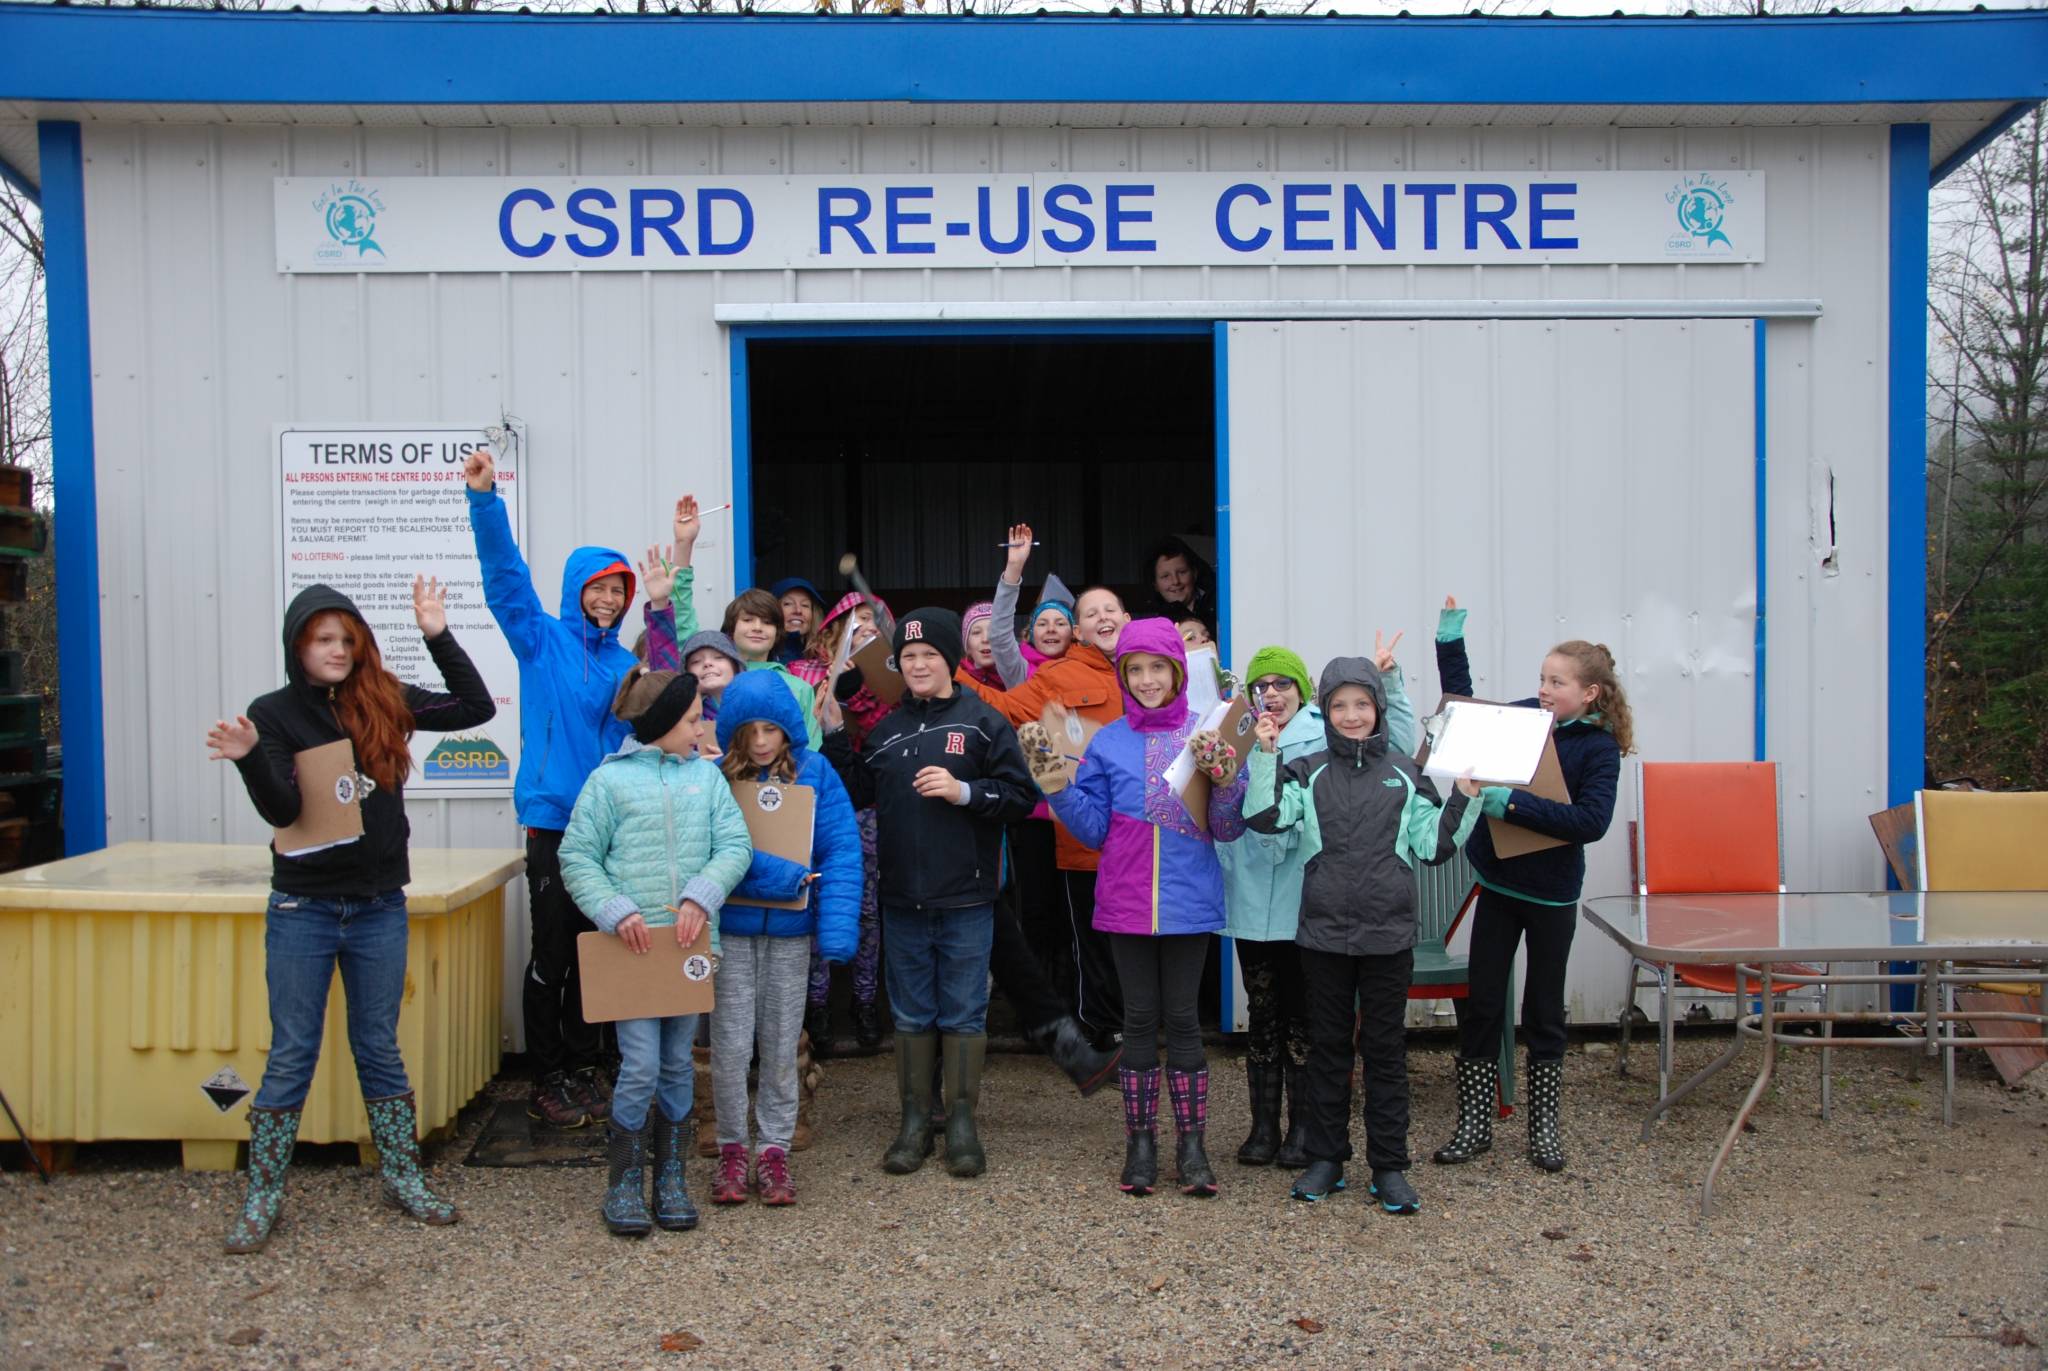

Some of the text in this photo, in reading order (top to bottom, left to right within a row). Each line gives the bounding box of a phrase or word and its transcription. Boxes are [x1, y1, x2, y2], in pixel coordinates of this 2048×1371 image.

[500, 182, 1579, 257] CSRD RE-USE CENTRE
[1668, 240, 1692, 249] CSRD
[309, 443, 393, 464] TERMS
[401, 443, 433, 464] OF
[285, 472, 299, 482] ALL
[301, 472, 334, 482] PERSONS
[336, 472, 373, 482] ENTERING
[375, 472, 389, 481] THE
[391, 471, 419, 481] CENTRE
[421, 471, 432, 481] DO
[434, 471, 444, 481] SO
[445, 471, 455, 481] AT
[498, 471, 515, 481] RISK
[290, 488, 315, 496] Please
[316, 488, 350, 497] complete
[351, 488, 397, 496] transactions
[399, 488, 409, 496] for
[411, 488, 440, 497] garbage
[292, 498, 323, 507] entering
[415, 498, 435, 507] weigh
[313, 518, 329, 526] may
[342, 516, 375, 524] removed
[435, 515, 450, 523] free
[334, 525, 366, 533] REPORT
[369, 525, 380, 533] TO
[382, 525, 397, 533] THE
[399, 525, 454, 533] SCALEHOUSE
[298, 535, 335, 543] SALVAGE
[291, 552, 303, 561] NO
[305, 552, 345, 561] LOITERING
[350, 553, 373, 561] please
[375, 552, 390, 560] limit
[392, 554, 409, 562] your
[318, 572, 333, 581] help
[345, 572, 360, 581] keep
[363, 581, 385, 589] goods
[445, 580, 475, 589] shelving
[355, 593, 376, 601] MUST
[391, 603, 415, 611] subjec
[453, 603, 482, 611] disposal
[905, 621, 923, 640] R
[389, 635, 421, 644] Clothing
[391, 645, 419, 654] Liquids
[385, 654, 426, 662] Mattresses
[396, 663, 416, 671] Food
[945, 732, 965, 755] R
[437, 751, 499, 769] CSRD
